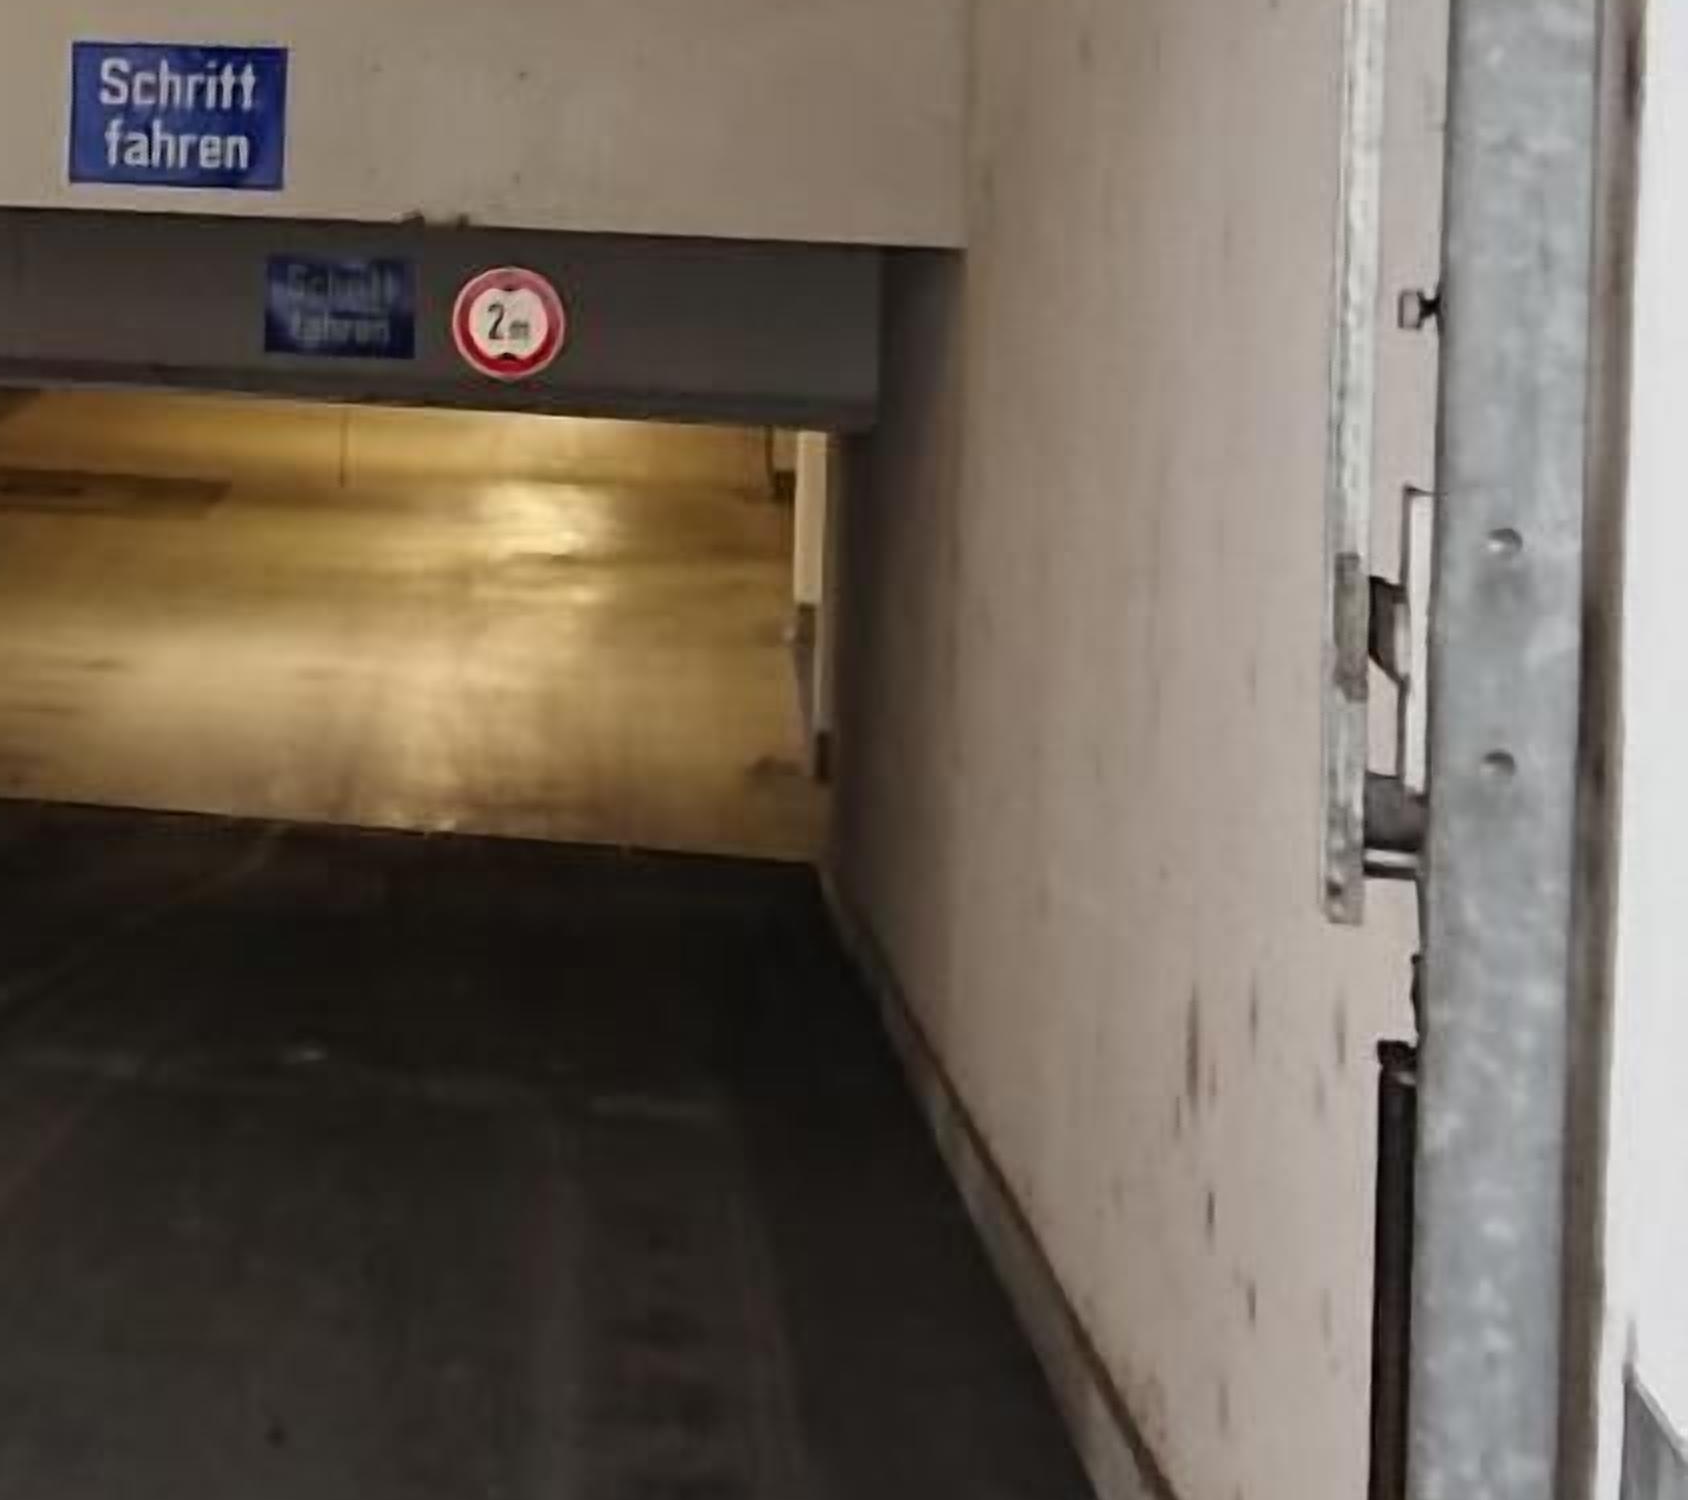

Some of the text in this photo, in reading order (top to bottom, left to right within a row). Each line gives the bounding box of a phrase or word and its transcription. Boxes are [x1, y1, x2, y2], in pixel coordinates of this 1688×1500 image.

[100, 57, 256, 110] Schritt
[104, 119, 249, 169] fahren
[487, 302, 505, 340] 2
